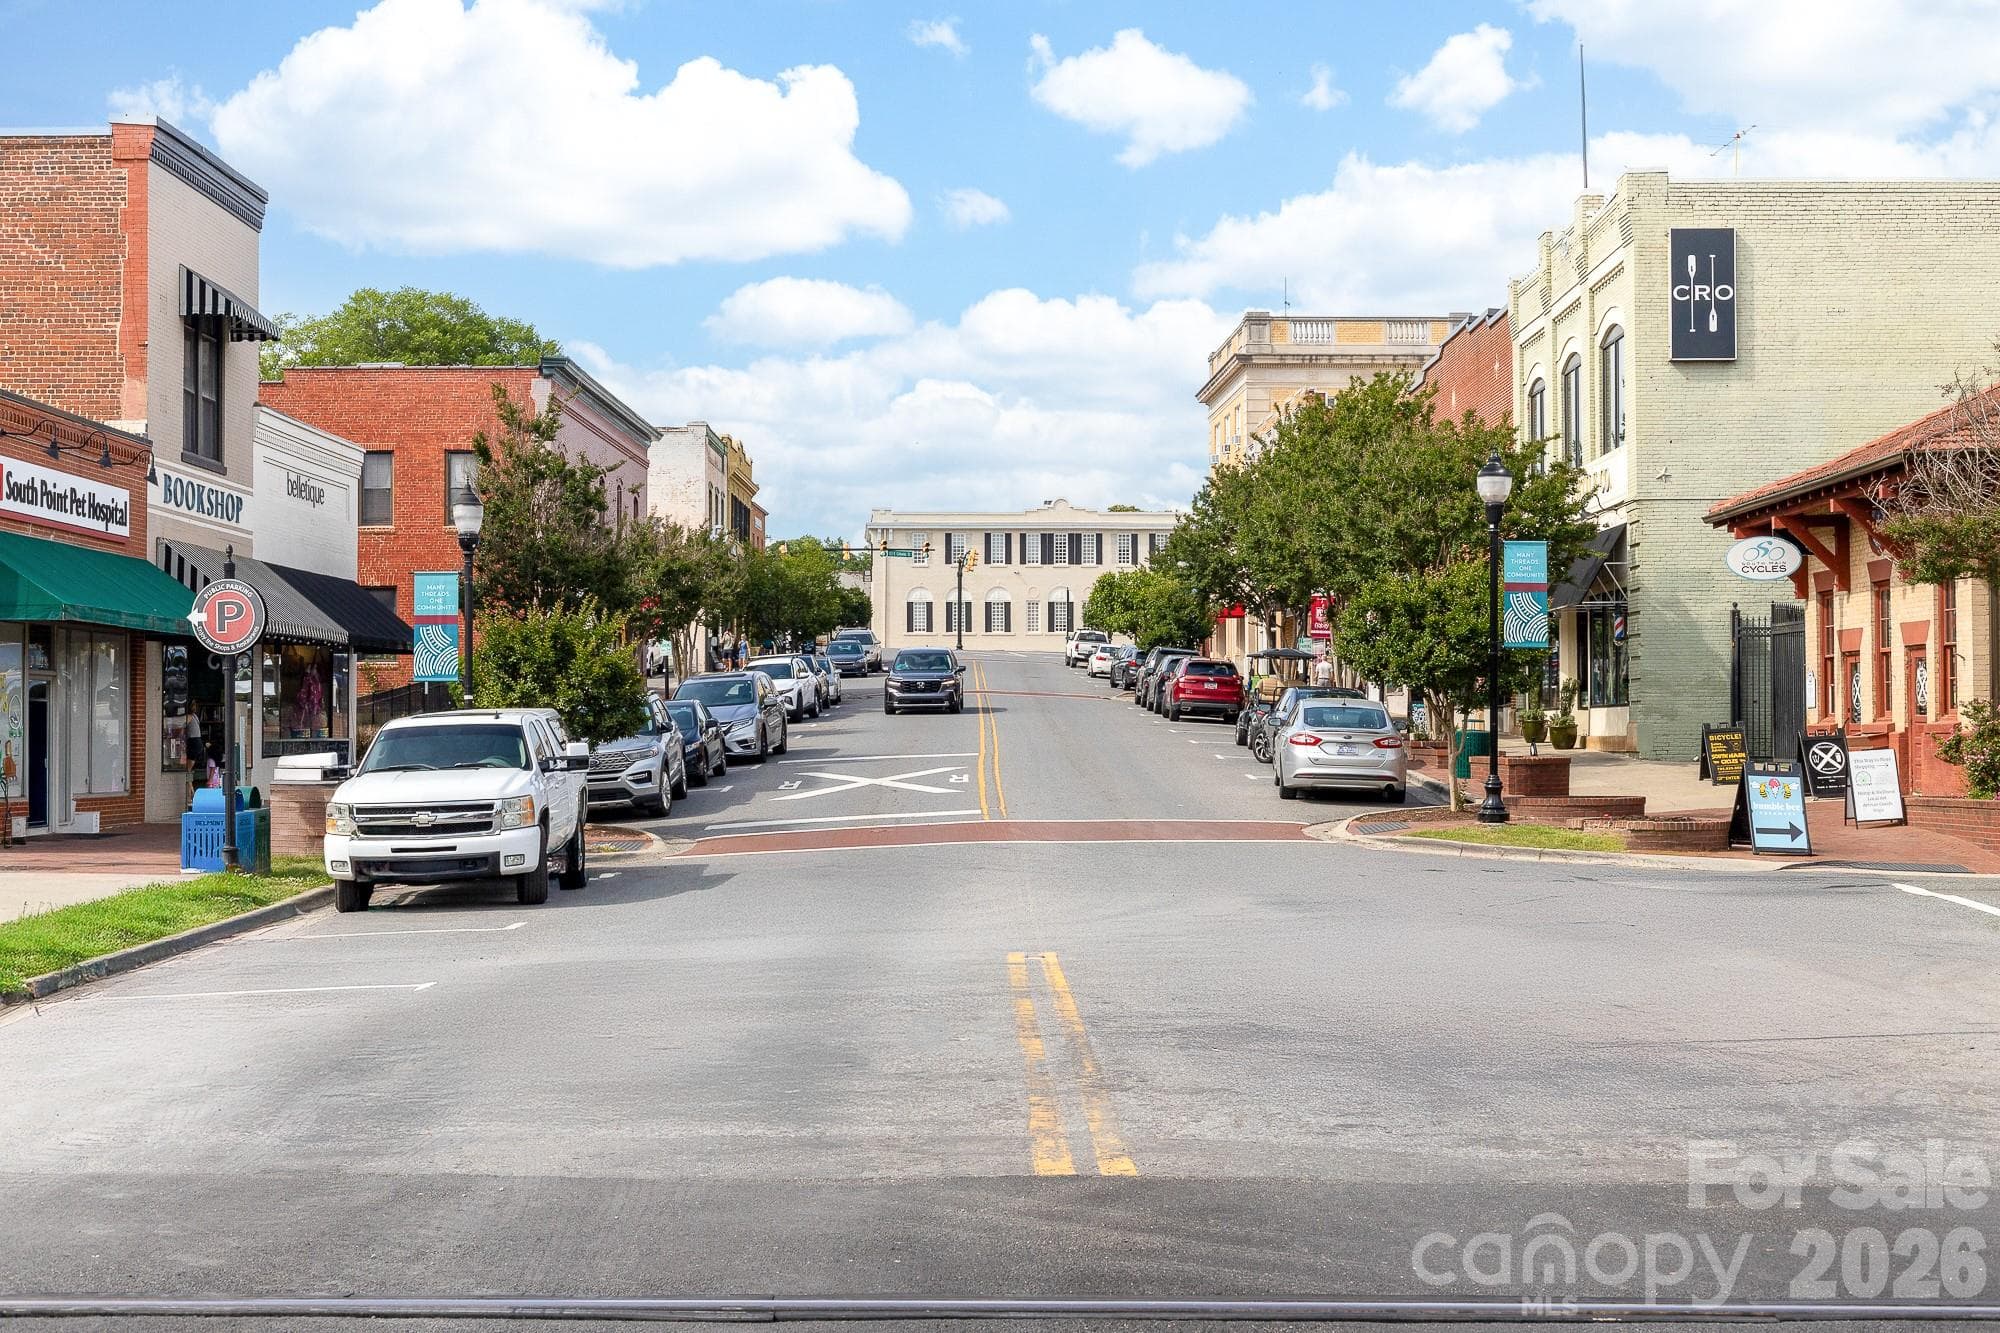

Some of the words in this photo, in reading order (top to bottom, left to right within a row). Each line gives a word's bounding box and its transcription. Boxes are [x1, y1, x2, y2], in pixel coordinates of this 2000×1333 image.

[5, 470, 38, 506] South
[40, 479, 68, 513] Point
[70, 487, 86, 518] Pet
[88, 491, 127, 531] Hospital
[163, 473, 243, 523] BOOKSHOP
[286, 471, 325, 508] belletique
[1741, 565, 1787, 573] CYCLES
[203, 583, 225, 599] PUBLIC
[226, 583, 253, 598] PARKING
[216, 599, 246, 634] P
[416, 603, 456, 611] COMMUNITY
[196, 625, 207, 642] Enjoy
[214, 643, 230, 652] Shops
[1753, 801, 1785, 811] bumble
[1786, 802, 1801, 811] bee
